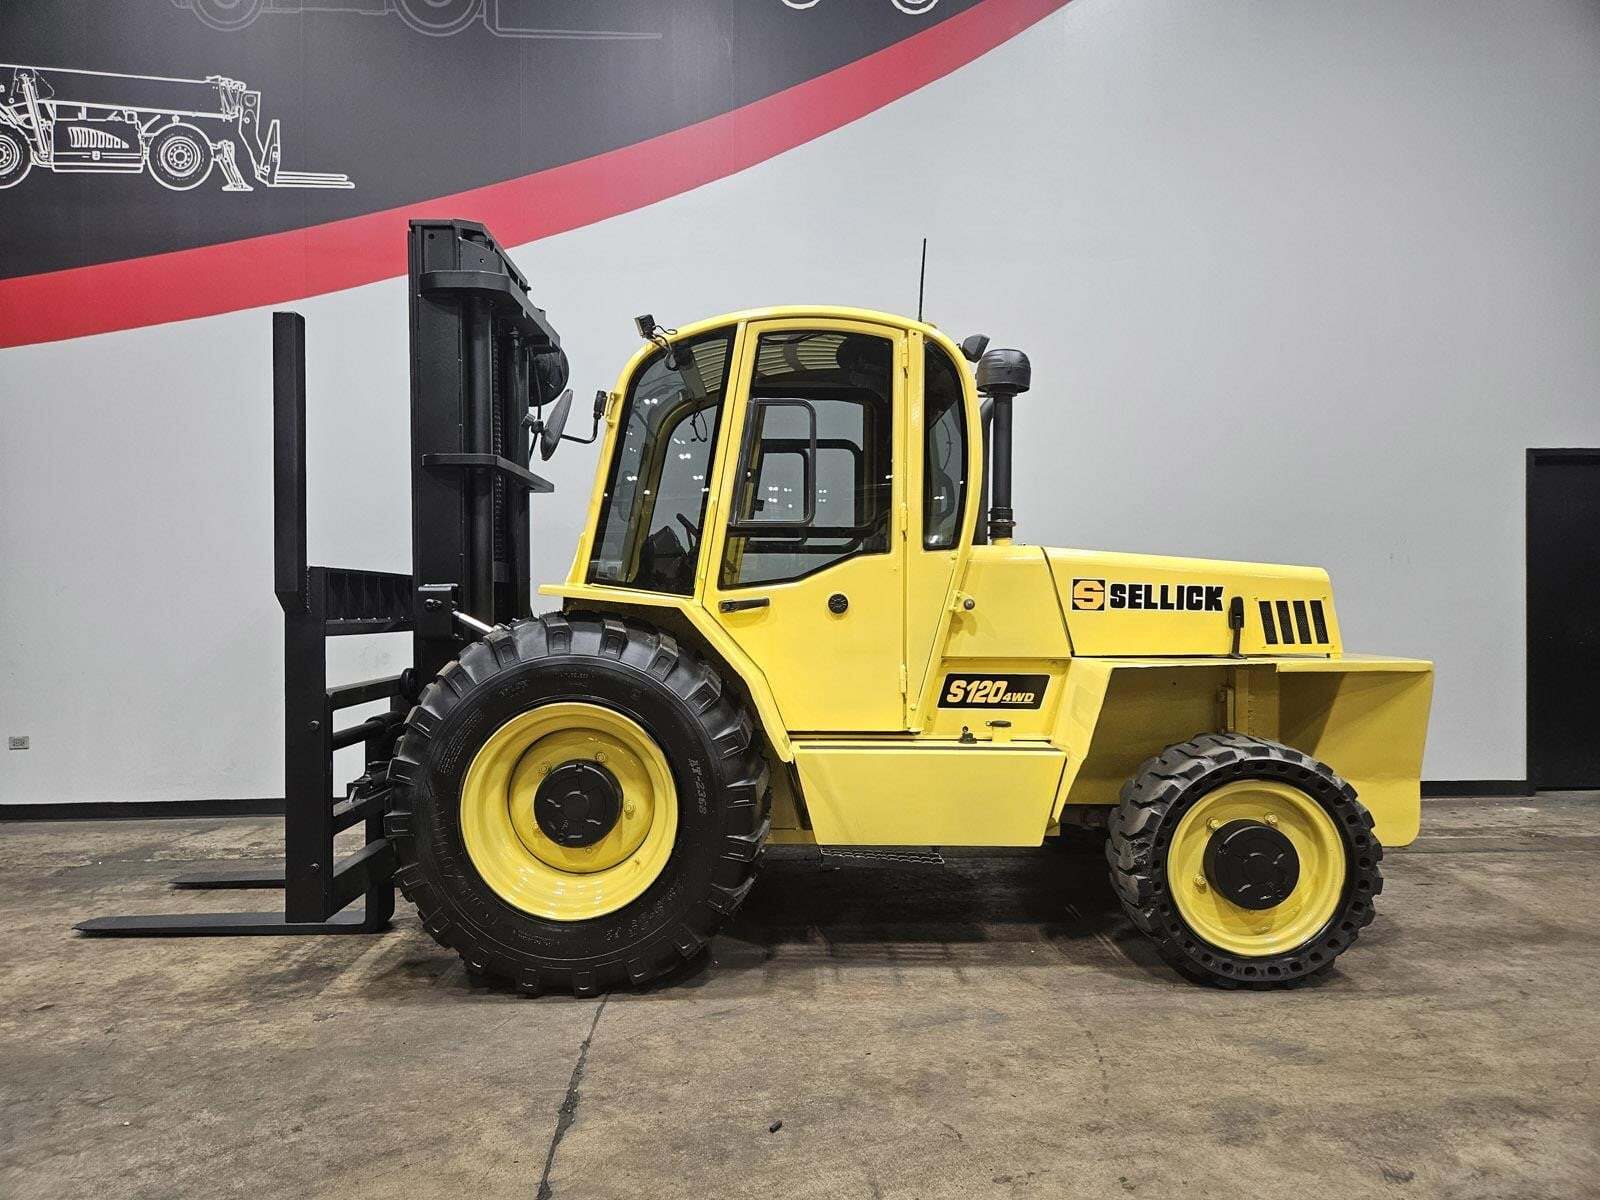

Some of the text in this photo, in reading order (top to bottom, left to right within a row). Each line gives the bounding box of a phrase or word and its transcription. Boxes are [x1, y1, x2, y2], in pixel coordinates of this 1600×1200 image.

[1110, 583, 1223, 611] SELLICK
[946, 680, 1035, 703] S120 4WD
